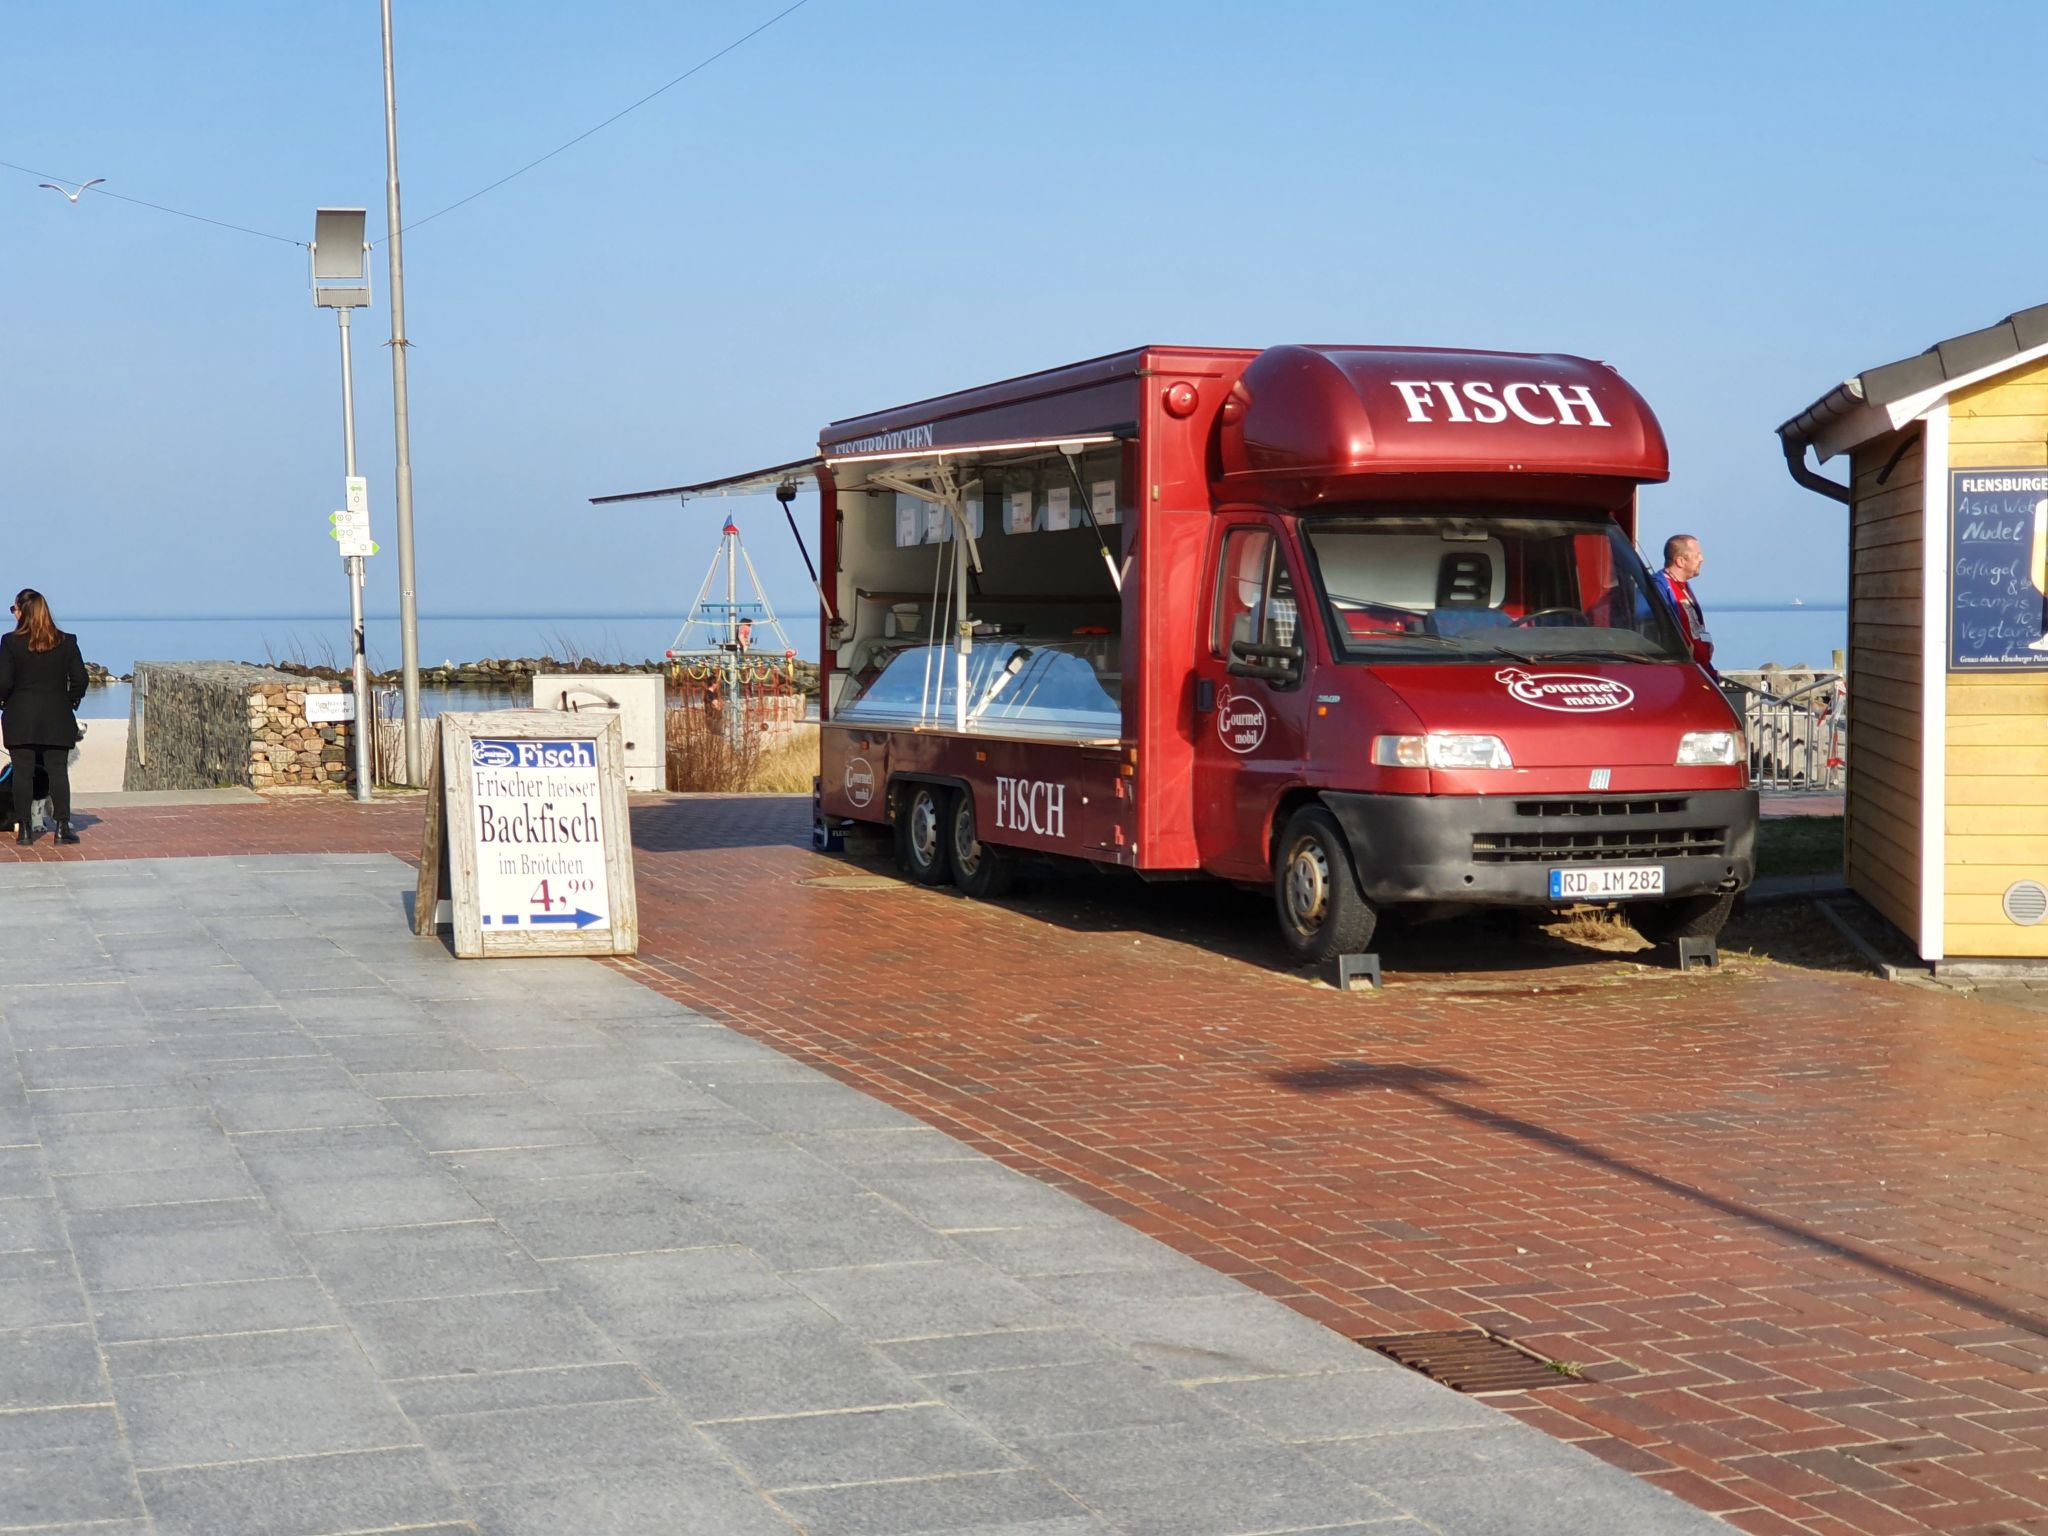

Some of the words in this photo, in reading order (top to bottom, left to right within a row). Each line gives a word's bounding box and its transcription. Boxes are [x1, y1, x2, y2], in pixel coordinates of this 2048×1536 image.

[1391, 381, 1612, 427] FISCH
[1962, 520, 2025, 541] Nudel
[1514, 681, 1622, 698] Gourmet
[1563, 694, 1619, 706] mobil
[1220, 707, 1263, 732] Gourmet
[1235, 730, 1258, 744] mobil
[516, 742, 592, 767] Fisch
[476, 771, 543, 797] Frischer
[547, 776, 597, 797] heisser
[996, 776, 1066, 838] FISCH
[478, 802, 599, 843] Backfisch
[499, 852, 517, 875] im
[521, 852, 584, 875] Brötchen
[1563, 873, 1588, 892] RD
[1602, 871, 1624, 891] IM
[1628, 870, 1662, 890] 282
[530, 879, 594, 911] 4,90
